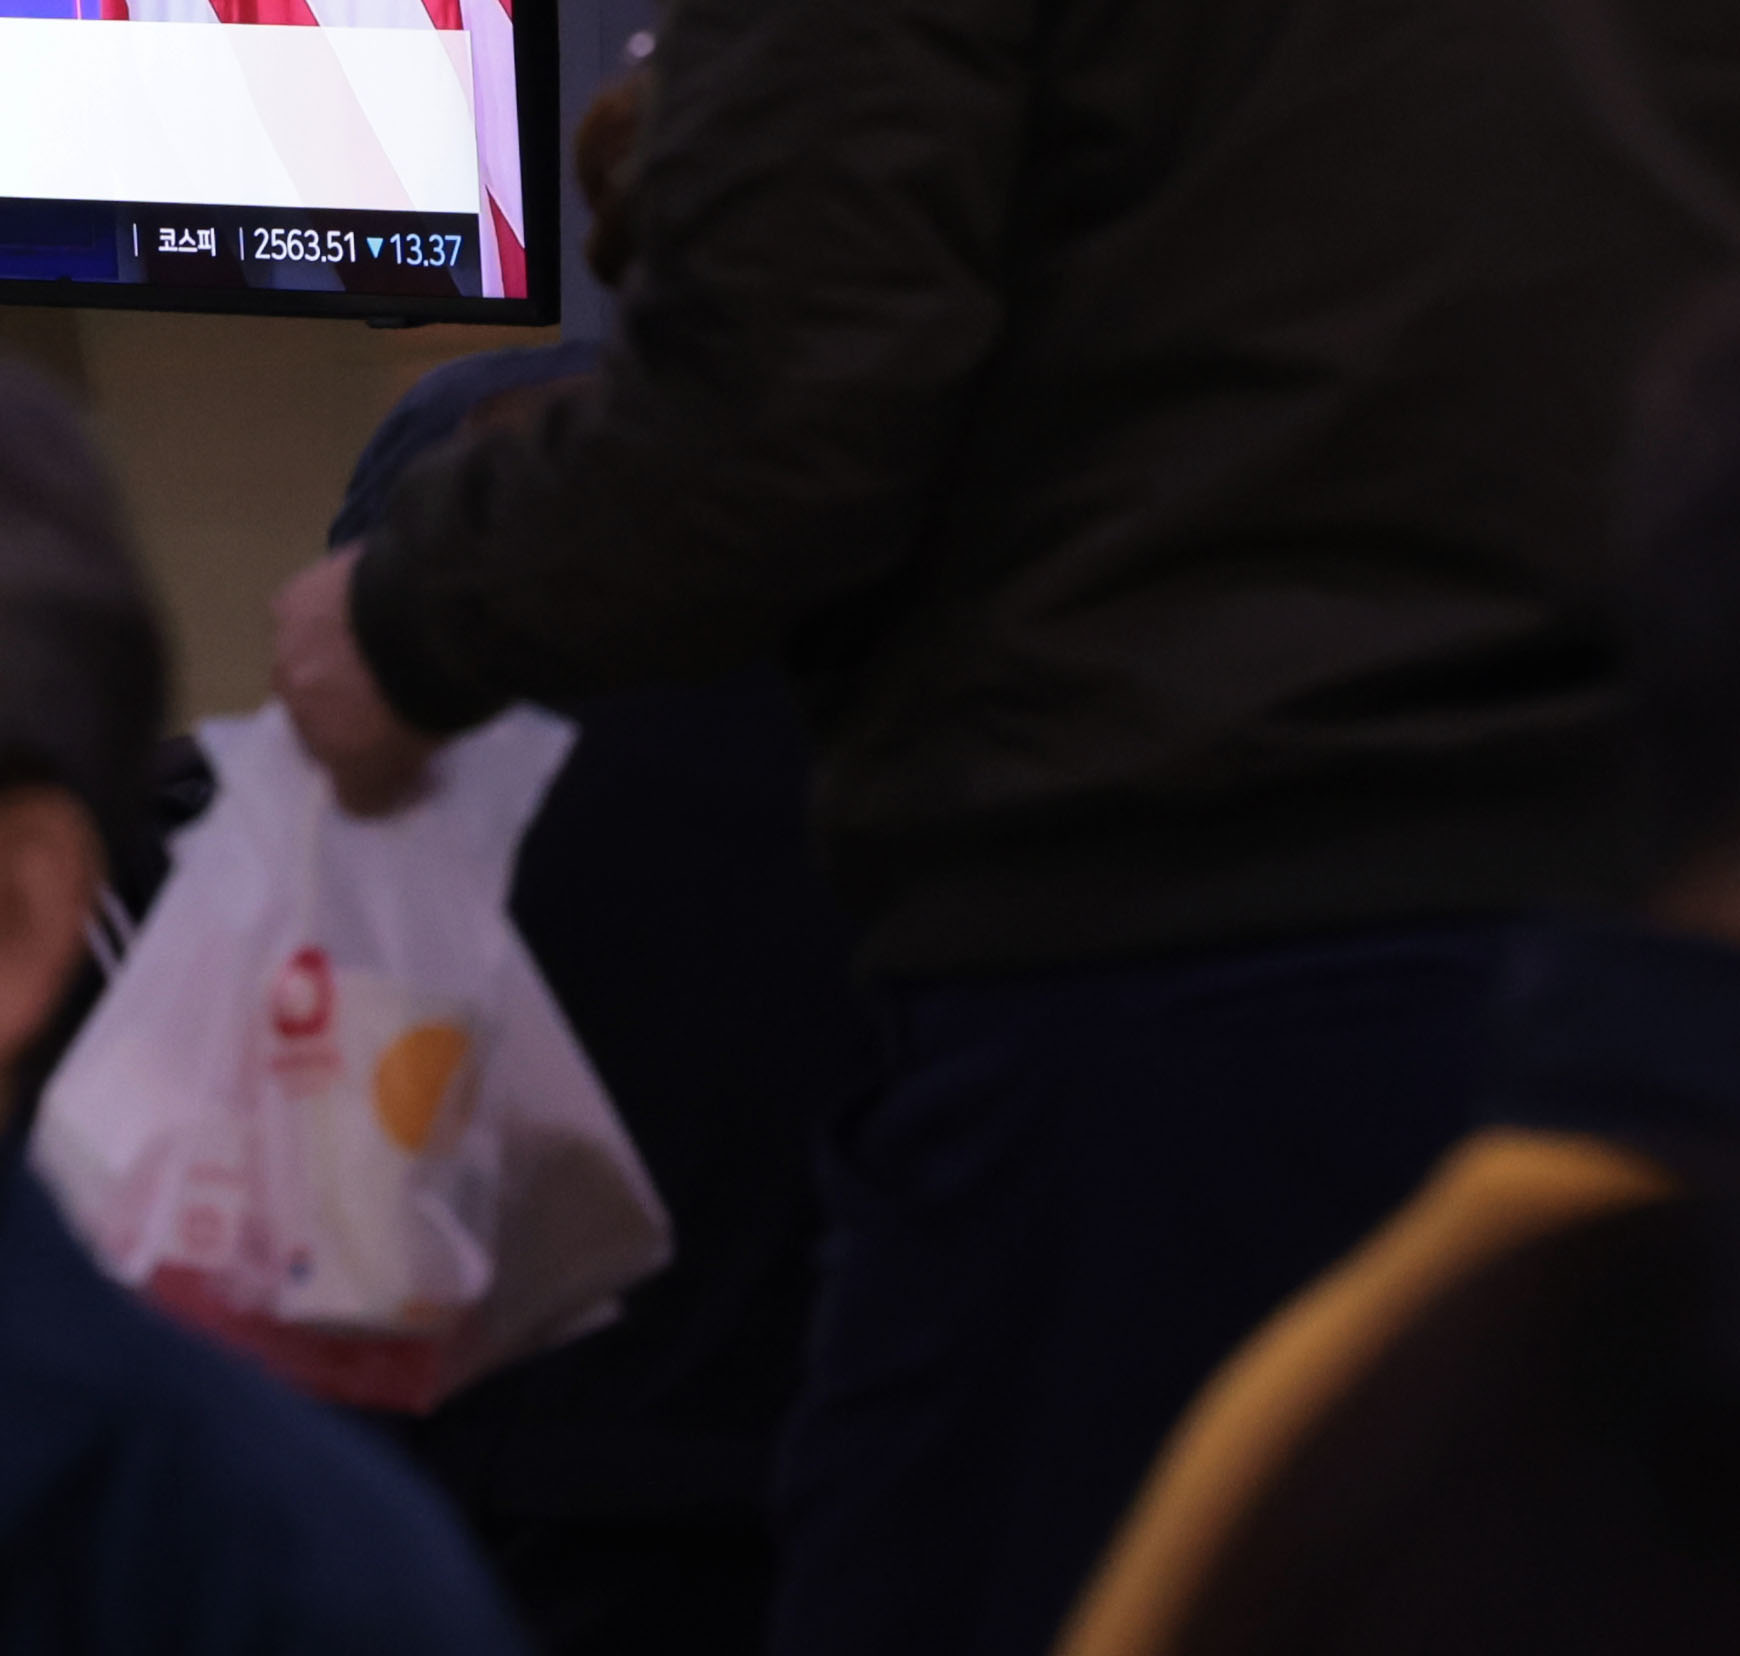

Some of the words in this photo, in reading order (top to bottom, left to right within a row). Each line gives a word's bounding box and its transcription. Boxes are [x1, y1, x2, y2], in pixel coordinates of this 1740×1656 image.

[158, 227, 217, 257] 코스피
[253, 228, 357, 262] 2563.51
[389, 233, 463, 267] 13.37
